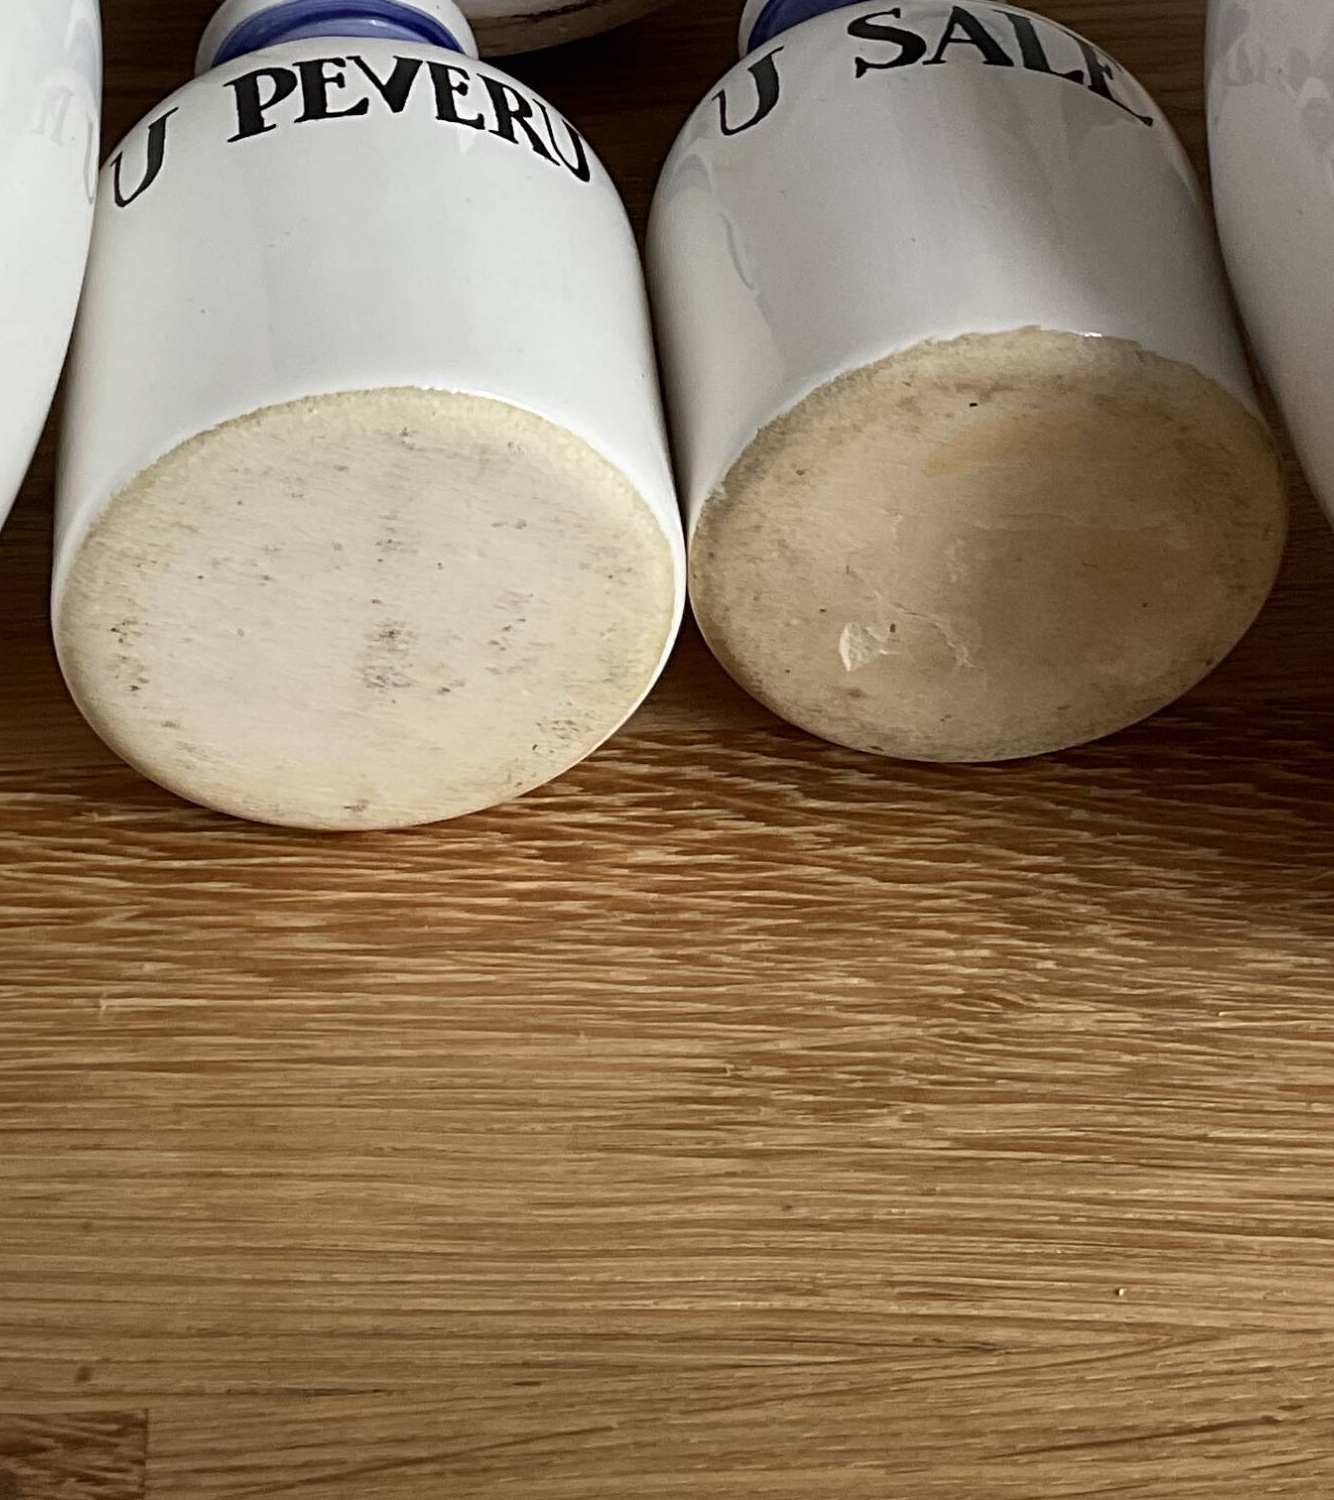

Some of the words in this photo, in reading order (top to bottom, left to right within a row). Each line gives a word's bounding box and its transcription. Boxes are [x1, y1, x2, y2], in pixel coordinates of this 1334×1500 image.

[110, 107, 178, 207] U
[224, 55, 591, 183] PEVERU
[712, 45, 785, 136] U
[847, 6, 1153, 127] SALE
